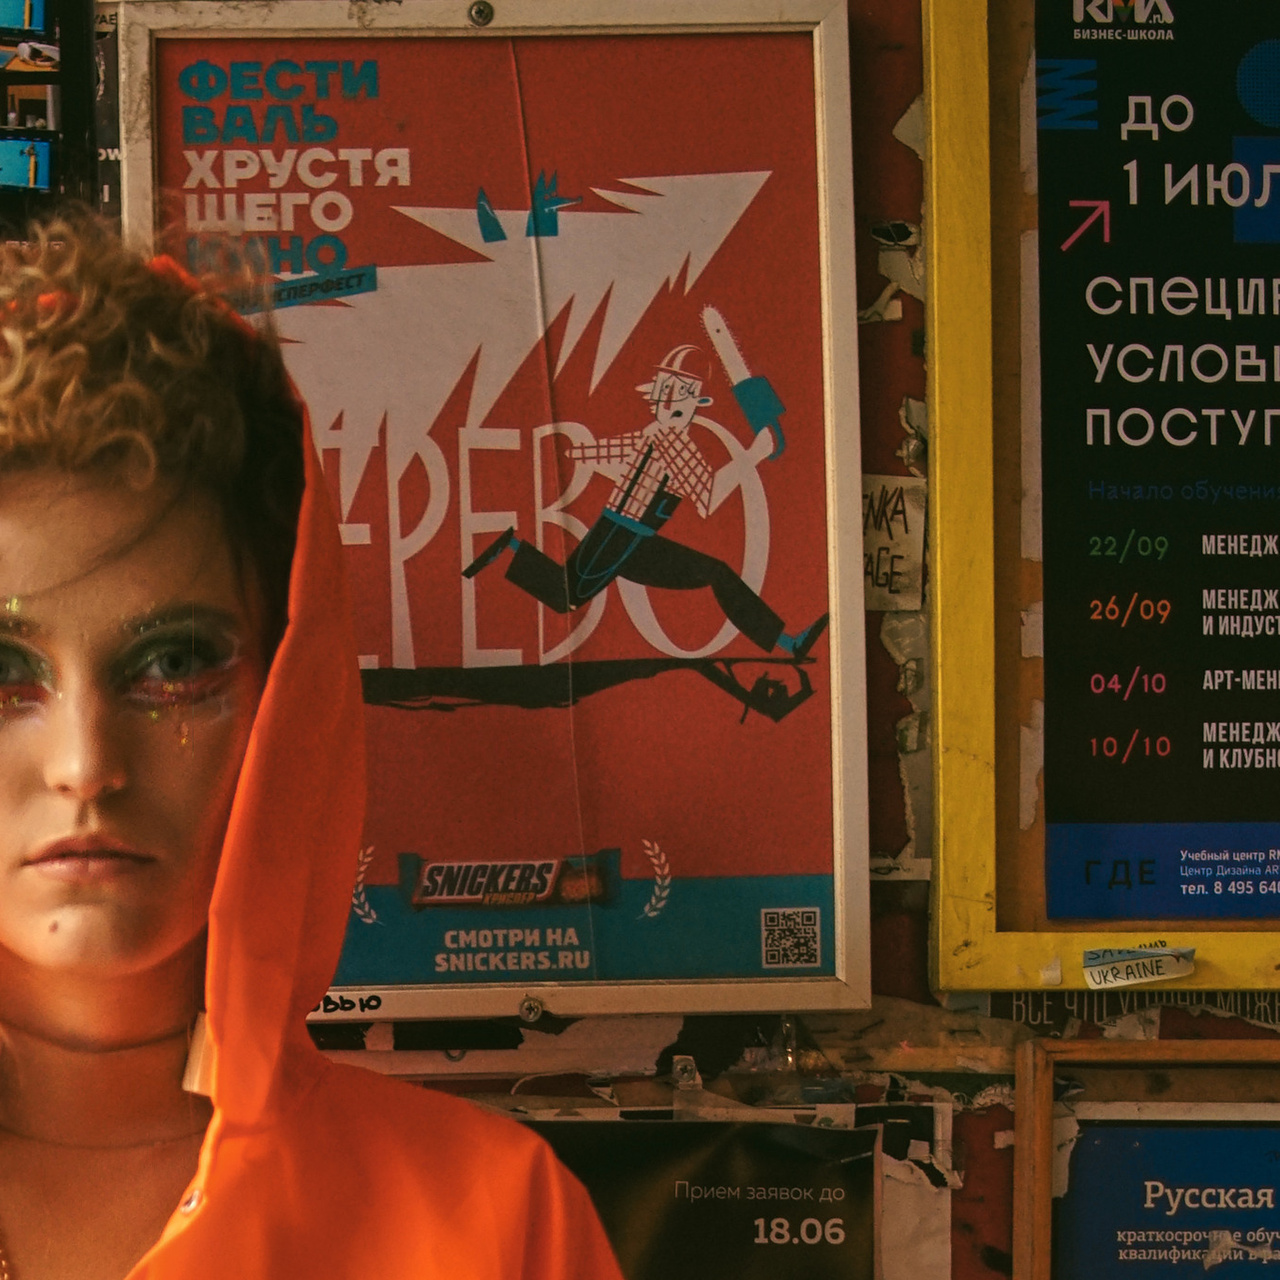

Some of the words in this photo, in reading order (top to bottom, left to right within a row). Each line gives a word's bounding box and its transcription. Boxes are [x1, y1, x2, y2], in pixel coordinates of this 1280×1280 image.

[1073, 29, 1175, 41] БИЗНЕС-ШКОЛА
[178, 60, 380, 102] ФЕСТИ
[182, 104, 338, 145] ВАЛЬ
[1120, 94, 1195, 141] ДО
[182, 147, 411, 189] ХРУСТЯ
[1123, 159, 1138, 205] 1
[185, 190, 354, 236] ЩЕГО
[1085, 276, 1280, 320] СПЕЦИ
[1086, 343, 1280, 383] УСЛОВ
[1088, 480, 1174, 501] Начало
[1089, 528, 1170, 564] 22/09
[1089, 592, 1172, 628] 26/09
[1202, 615, 1214, 636] И
[1090, 665, 1167, 702] 04/10
[1090, 728, 1172, 765] 10/10
[1202, 748, 1214, 769] И
[1219, 748, 1280, 769] КЛУБН
[1180, 849, 1230, 862] Учебный
[1232, 851, 1266, 863] центр
[1180, 865, 1214, 878] Центр
[1215, 864, 1262, 878] Дизайна
[422, 862, 555, 897] SNICKERS
[1084, 859, 1157, 890] ГДЕ
[1180, 884, 1210, 896] тел.
[1213, 881, 1223, 895] 8
[1227, 880, 1255, 895] 495
[444, 928, 540, 949] СМОТРИ
[547, 927, 580, 946] НА
[434, 950, 591, 973] SNICKERS.RU
[1089, 958, 1168, 986] UKRAINE
[674, 1180, 741, 1204] Прием
[746, 1186, 815, 1201] заявок
[819, 1187, 846, 1204] до
[1143, 1180, 1275, 1216] Русская
[753, 1217, 847, 1245] 18.06
